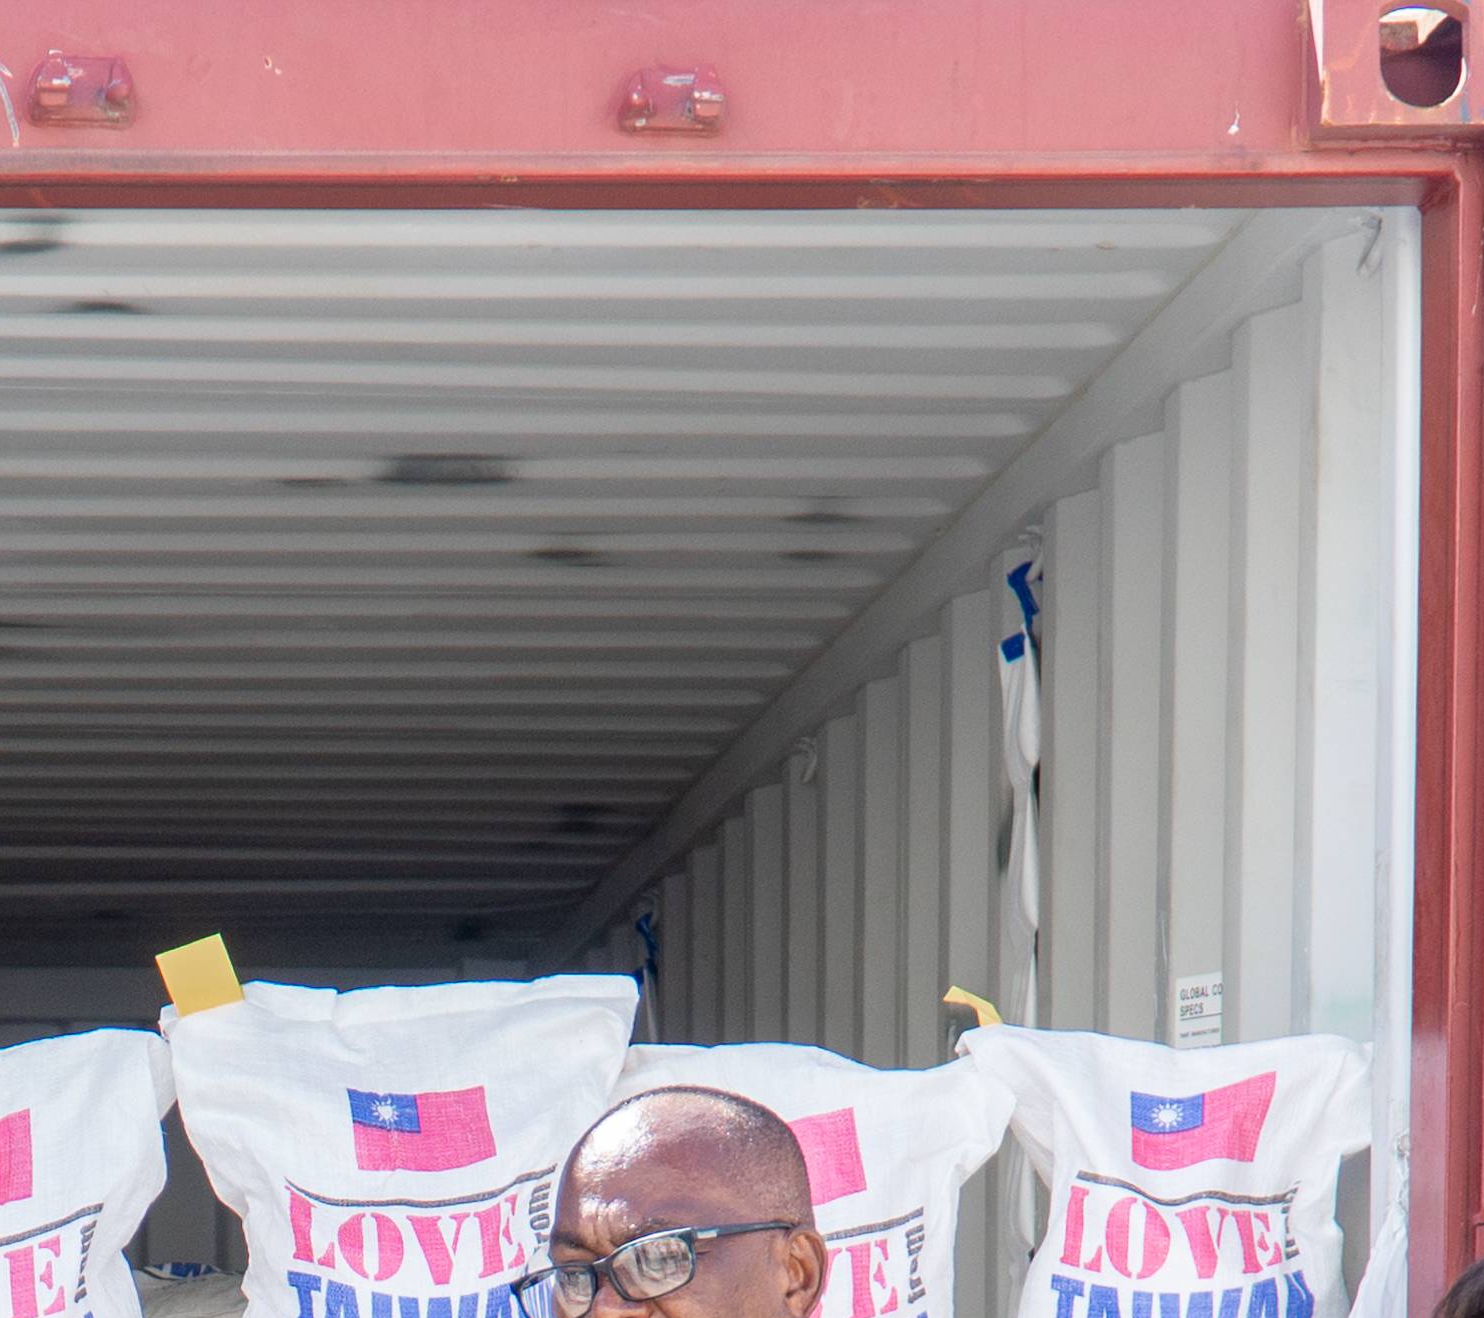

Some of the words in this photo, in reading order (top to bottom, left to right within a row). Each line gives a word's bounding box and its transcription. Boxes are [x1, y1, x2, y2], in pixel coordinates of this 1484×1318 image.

[1179, 984, 1209, 1001] GLOBAL
[1179, 1002, 1204, 1017] SPECS
[290, 1192, 526, 1285] LOVE
[1059, 1187, 1283, 1279] LOVE
